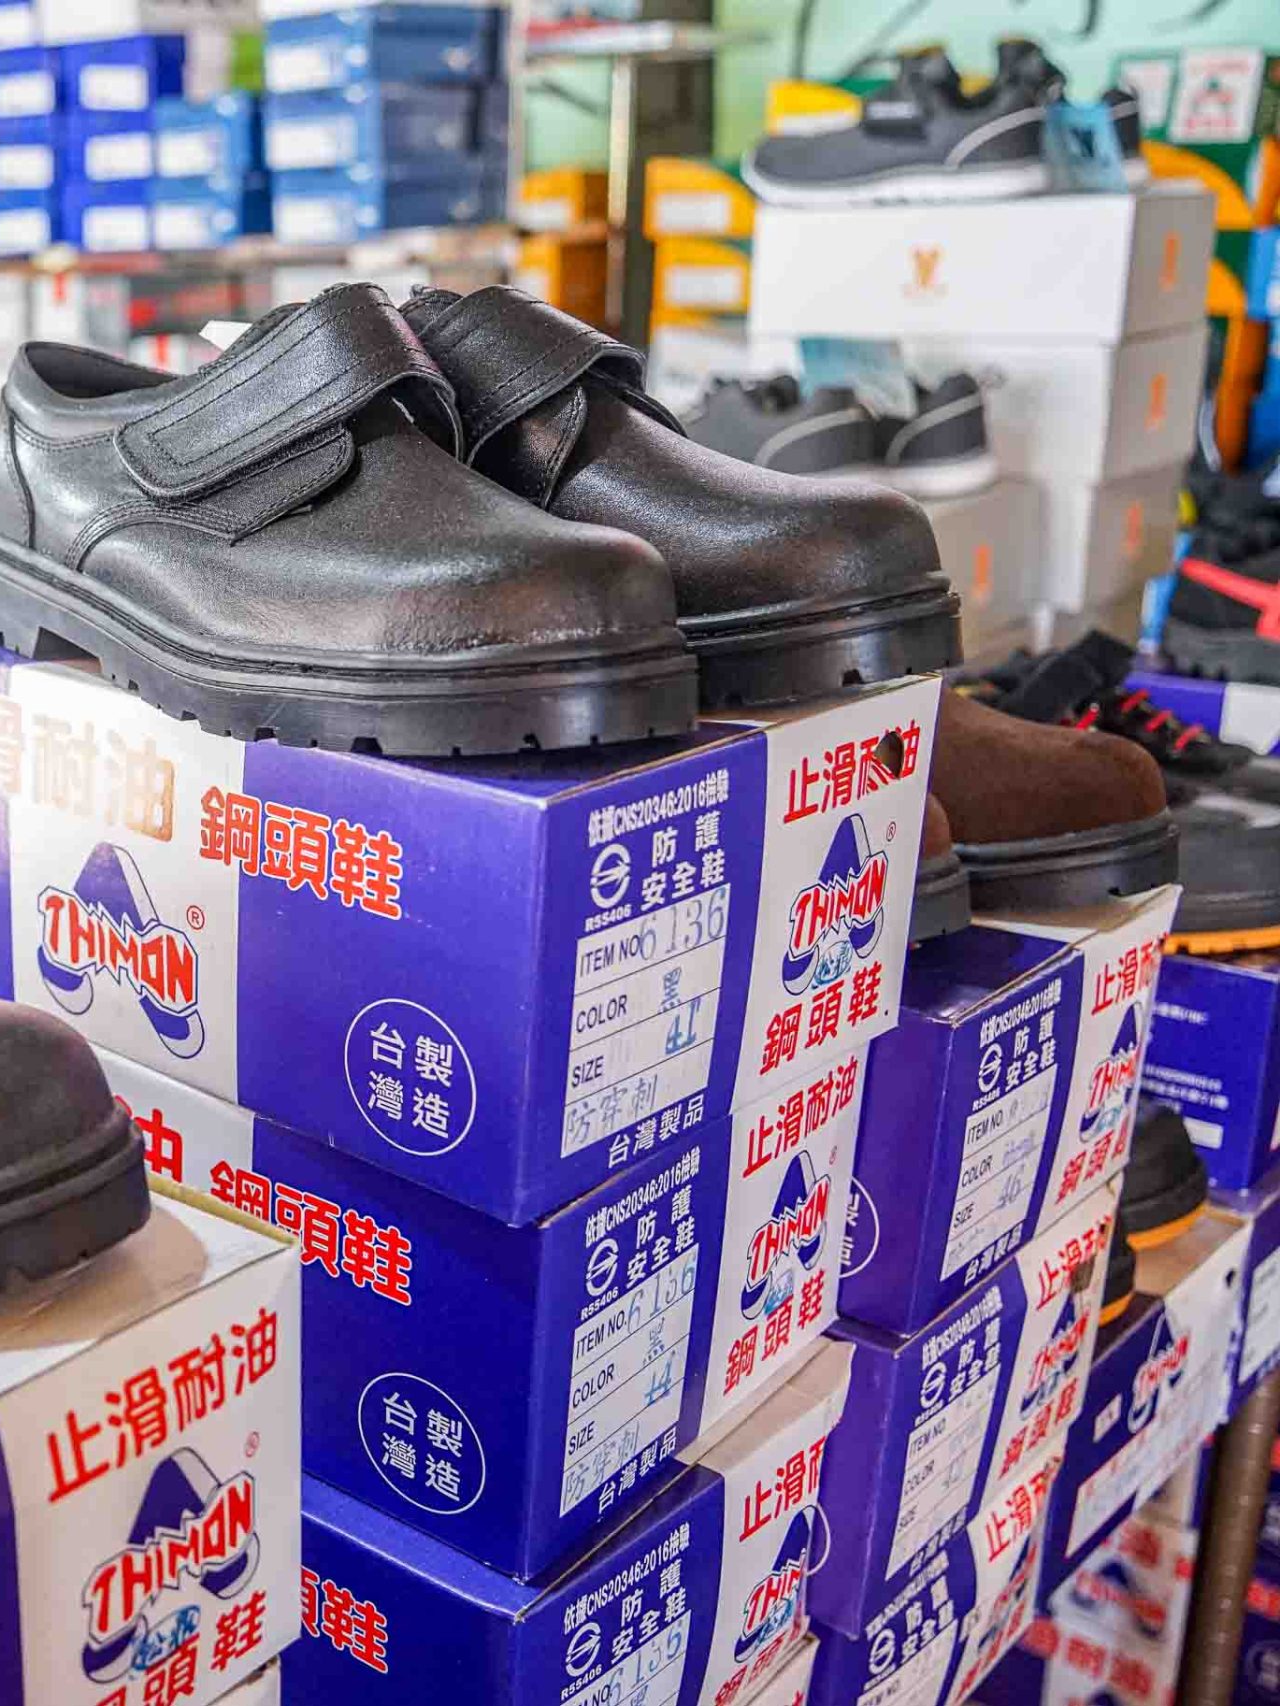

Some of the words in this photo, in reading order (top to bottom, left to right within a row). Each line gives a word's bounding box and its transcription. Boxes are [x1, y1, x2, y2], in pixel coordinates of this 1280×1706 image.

[199, 786, 403, 920] 鋼頭鞋
[652, 810, 721, 868] 防護
[641, 848, 725, 912] 安全鞋
[793, 858, 886, 949] THIMON
[46, 895, 193, 1003] THIMON
[580, 943, 615, 977] ITEM
[576, 995, 628, 1033] COLOR
[760, 960, 883, 1075] 鋼頭鞋
[572, 1056, 604, 1088] SIZE
[608, 1094, 704, 1168] 台灣製品
[742, 1055, 858, 1178] 止滑耐油
[961, 1155, 993, 1187] COLOR
[626, 1216, 695, 1289] 安全鞋
[636, 1185, 691, 1249] 防護
[751, 1181, 829, 1280] THIMON
[581, 1287, 619, 1321] R55406
[723, 1270, 824, 1396] 鋼頭鞋
[576, 1324, 605, 1359] ITEM
[48, 1307, 278, 1502] 止滑耐油
[572, 1363, 615, 1409] COLOR
[568, 1421, 596, 1455] SIZE
[598, 1427, 677, 1514] 台灣製品
[91, 1479, 253, 1632] THIMON
[611, 1587, 686, 1664] 安全鞋
[621, 1559, 682, 1627] 防護
[96, 1590, 266, 1706] 頭鞋
[561, 1664, 602, 1701] R55406
